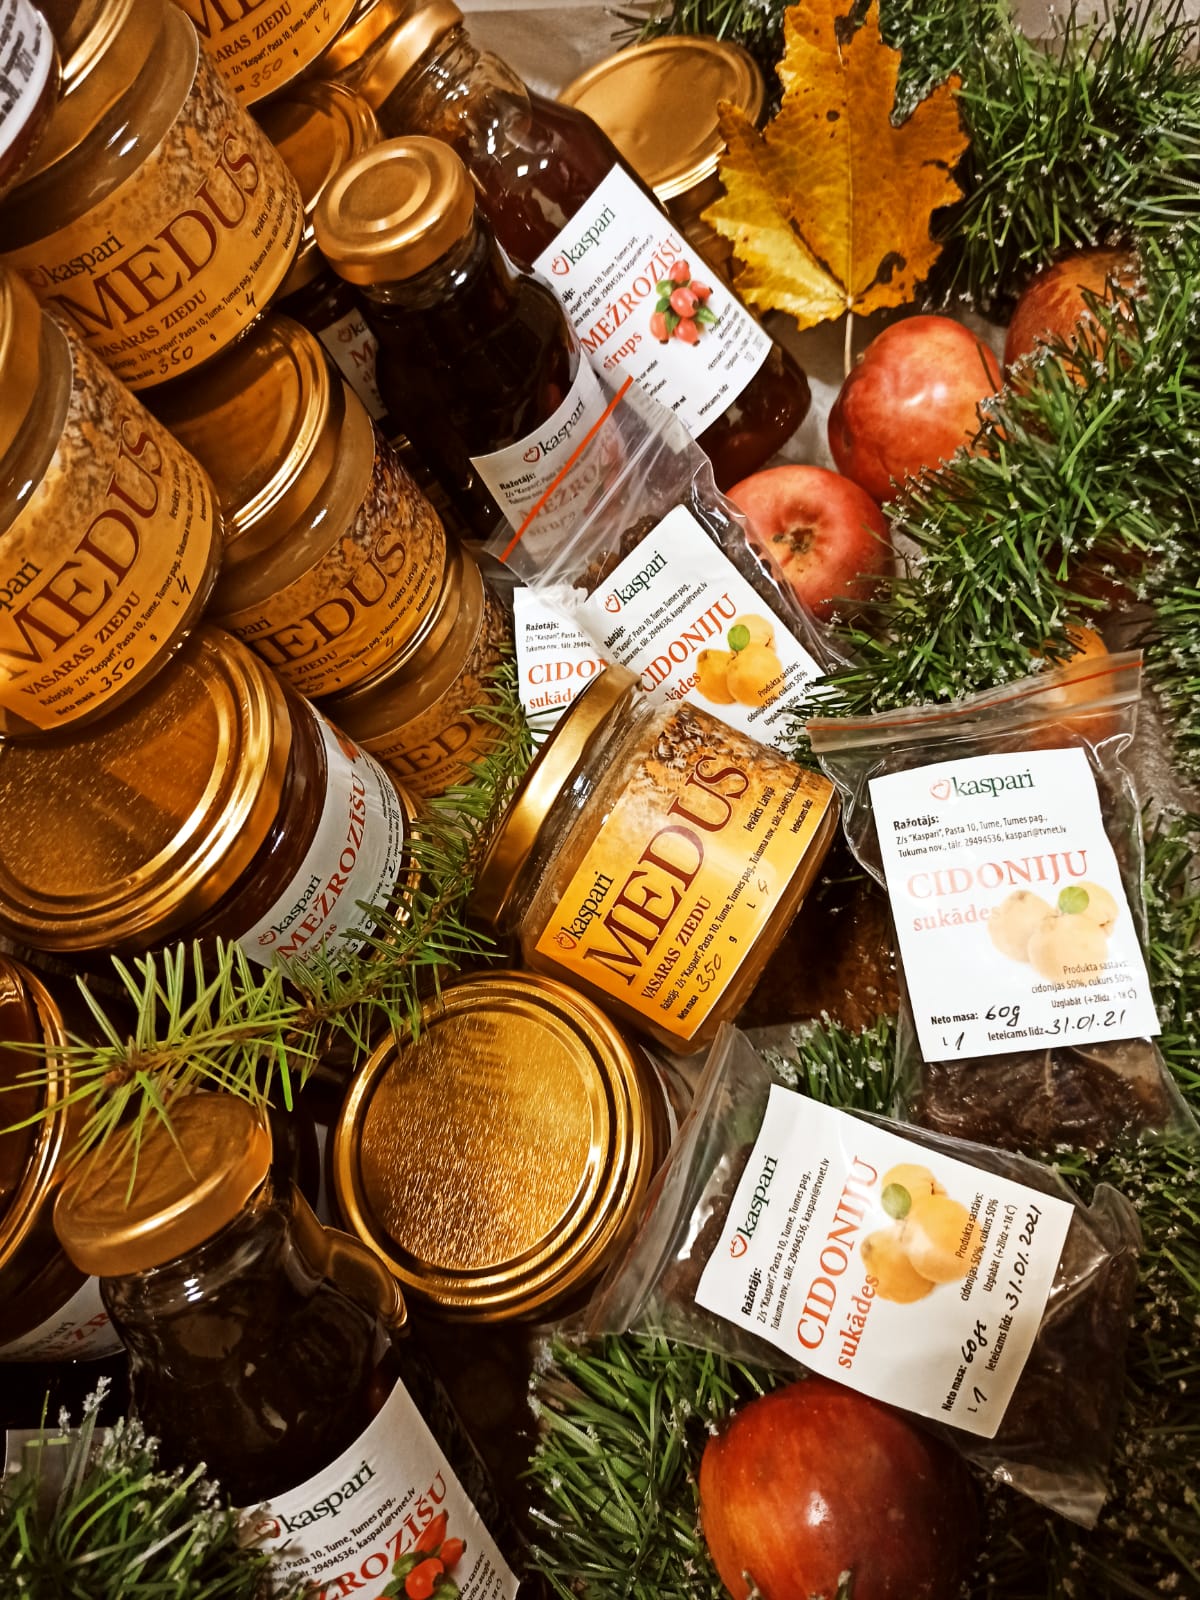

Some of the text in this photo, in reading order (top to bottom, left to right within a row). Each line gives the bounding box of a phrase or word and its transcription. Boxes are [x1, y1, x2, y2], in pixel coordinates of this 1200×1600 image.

[215, 34, 251, 64] ARAS
[252, 2, 293, 40] ZIEDU
[267, 38, 284, 53] Pasta
[251, 58, 283, 88] 350
[48, 133, 259, 338] MEDUS
[561, 203, 616, 266] kaspari
[42, 230, 125, 284] kaspari
[222, 284, 241, 304] Tumes
[580, 233, 682, 356] MEŽROZĪŠU
[583, 285, 597, 299] Pasta
[93, 289, 207, 357] VASARAS ZIEDU
[159, 346, 193, 374] 350
[209, 332, 217, 341] g
[603, 331, 643, 371] sīrups
[538, 397, 586, 456] kaspari
[0, 417, 162, 681] MEDUS
[0, 557, 42, 613] pari
[613, 550, 668, 606] kaspari
[116, 632, 136, 651] Pasta
[155, 575, 173, 599] Tumes
[235, 615, 272, 641] pari
[632, 624, 646, 639] Pasta
[649, 603, 667, 621] Tume,
[662, 590, 680, 607] Tumes
[649, 616, 674, 639] 29494536,
[21, 592, 141, 695] VASARAS ZIEDU
[295, 650, 338, 674] ZIEDU
[640, 592, 737, 693] CIDONIJU
[55, 633, 157, 716] Neto masa 350 g
[665, 672, 702, 702] kādes
[758, 678, 781, 697] Produkta
[747, 703, 768, 723] cidonijas
[951, 768, 1036, 797] kaspari
[743, 807, 764, 832] Ievākts
[893, 814, 940, 831] Ražotājs:
[896, 835, 908, 845] Z/s
[944, 826, 966, 836] Pasta
[967, 823, 979, 832] 10,
[979, 819, 1003, 830] Tume,
[1003, 816, 1028, 826] Tumes
[749, 839, 769, 864] Tukuma
[898, 846, 928, 858] Tukuma
[965, 833, 1005, 847] 29494536,
[1005, 825, 1067, 841] kaspari@tvnet.lv
[276, 773, 366, 960] MEŽROZĪŠU
[583, 755, 749, 986] MEDUS
[907, 850, 1088, 899] CIDONIJU
[271, 874, 323, 935] kaspari
[566, 871, 615, 940] kaspari
[727, 880, 746, 903] Tumes
[709, 923, 722, 934] 10,
[715, 903, 734, 923] Tume,
[913, 902, 1001, 932] sukādes
[641, 896, 711, 999] VASARAS ZIEDU
[698, 934, 714, 952] Pasta
[677, 935, 738, 1021] Neto masa 350 g
[1031, 982, 1066, 994] cidonijas
[1088, 976, 1114, 986] cukurs
[1063, 964, 1098, 975] Produkta
[931, 1004, 1021, 1027] Neto masa: 60g
[988, 1027, 1028, 1042] Ieteicams
[737, 1155, 779, 1240] kaspari
[789, 1189, 804, 1217] Tumes
[802, 1157, 830, 1224] kaspari@tvnet.lv
[778, 1239, 788, 1251] 10,
[781, 1214, 795, 1242] Tume,
[788, 1222, 809, 1265] 29494536,
[955, 1192, 984, 1259] Produkta sastāvs:
[769, 1251, 783, 1274] Pasta
[797, 1154, 878, 1349] CIDONIJU
[960, 1199, 999, 1301] cidonijas 50%, cukurs 50%
[741, 1267, 763, 1316] Ražotājs:
[783, 1264, 795, 1283] tālr.
[982, 1259, 1000, 1292] Uzglabāt
[757, 1310, 768, 1324] Z/s
[770, 1300, 785, 1331] Tukuma
[837, 1274, 880, 1368] sukādes
[984, 1331, 1007, 1372] Ieteicams
[998, 1314, 1013, 1332] līdz
[941, 1390, 957, 1412] Neto
[952, 1365, 967, 1391] masa:
[276, 1460, 377, 1534] kaspari
[287, 1555, 311, 1569] Pasta
[310, 1550, 326, 1561] 10,
[323, 1534, 352, 1553] Tume,
[350, 1515, 378, 1537] Tumes
[311, 1487, 416, 1574] 29494536, kaspari@tvnet.lv
